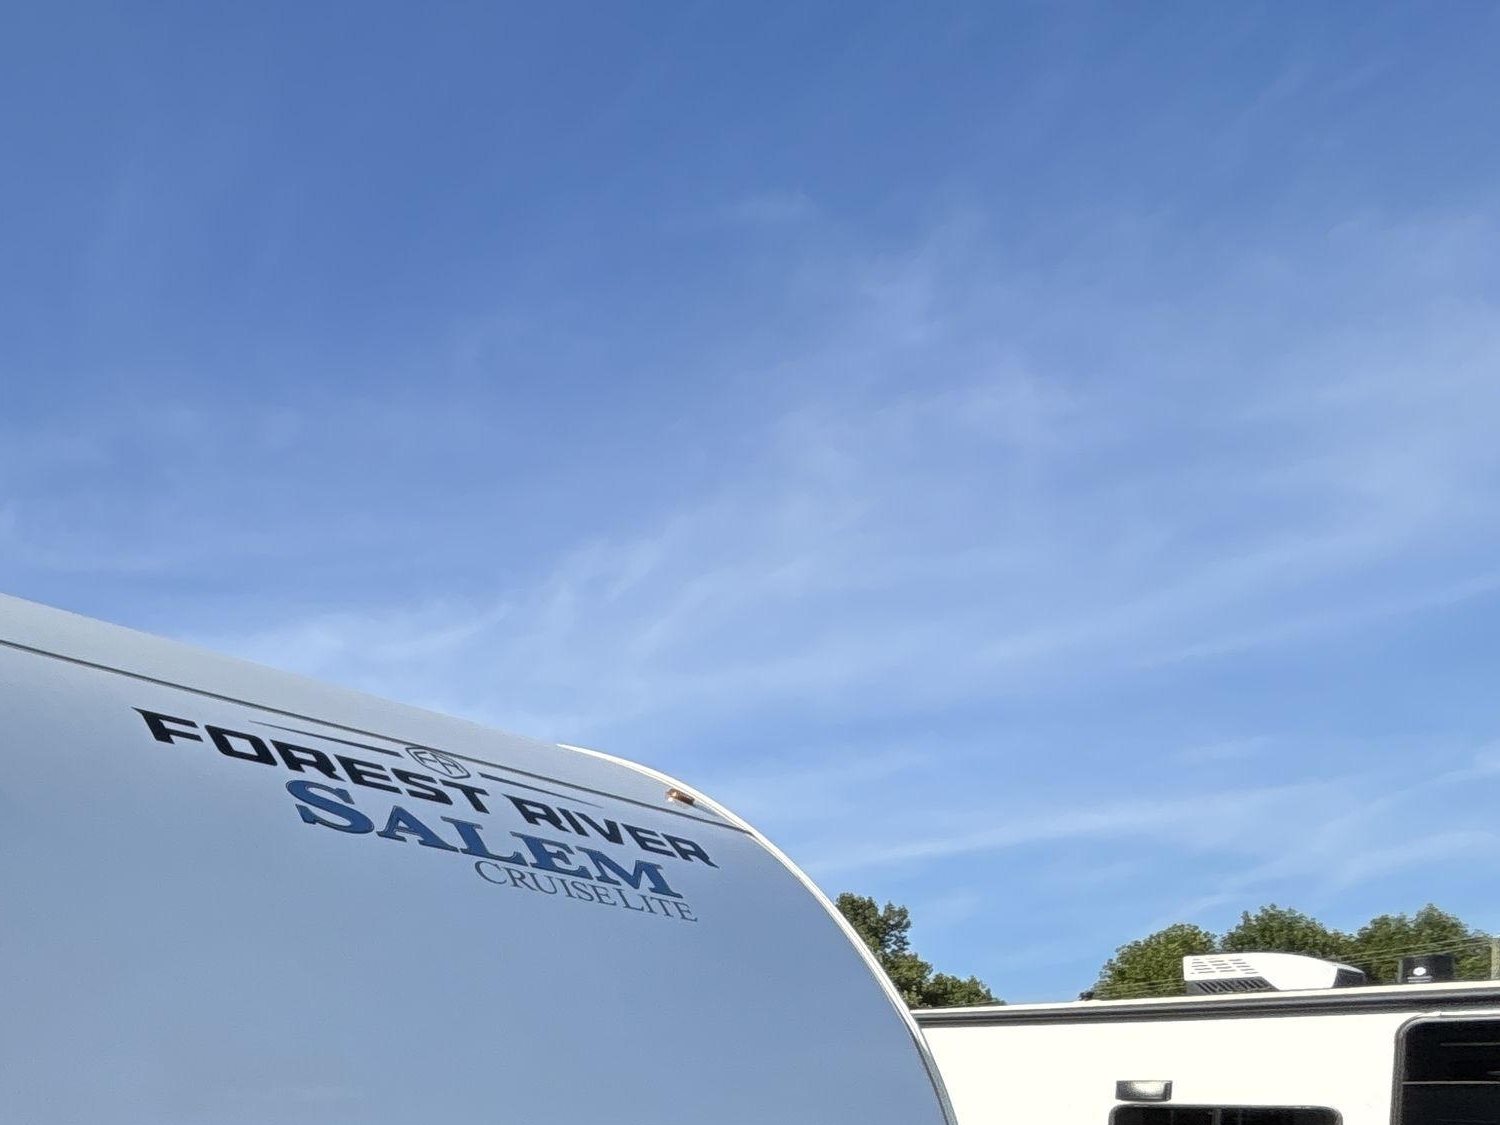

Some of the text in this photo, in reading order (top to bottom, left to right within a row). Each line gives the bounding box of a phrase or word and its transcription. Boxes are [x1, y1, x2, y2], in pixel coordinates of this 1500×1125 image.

[132, 706, 719, 868] FOREST RIVER
[285, 780, 683, 898] SALEM
